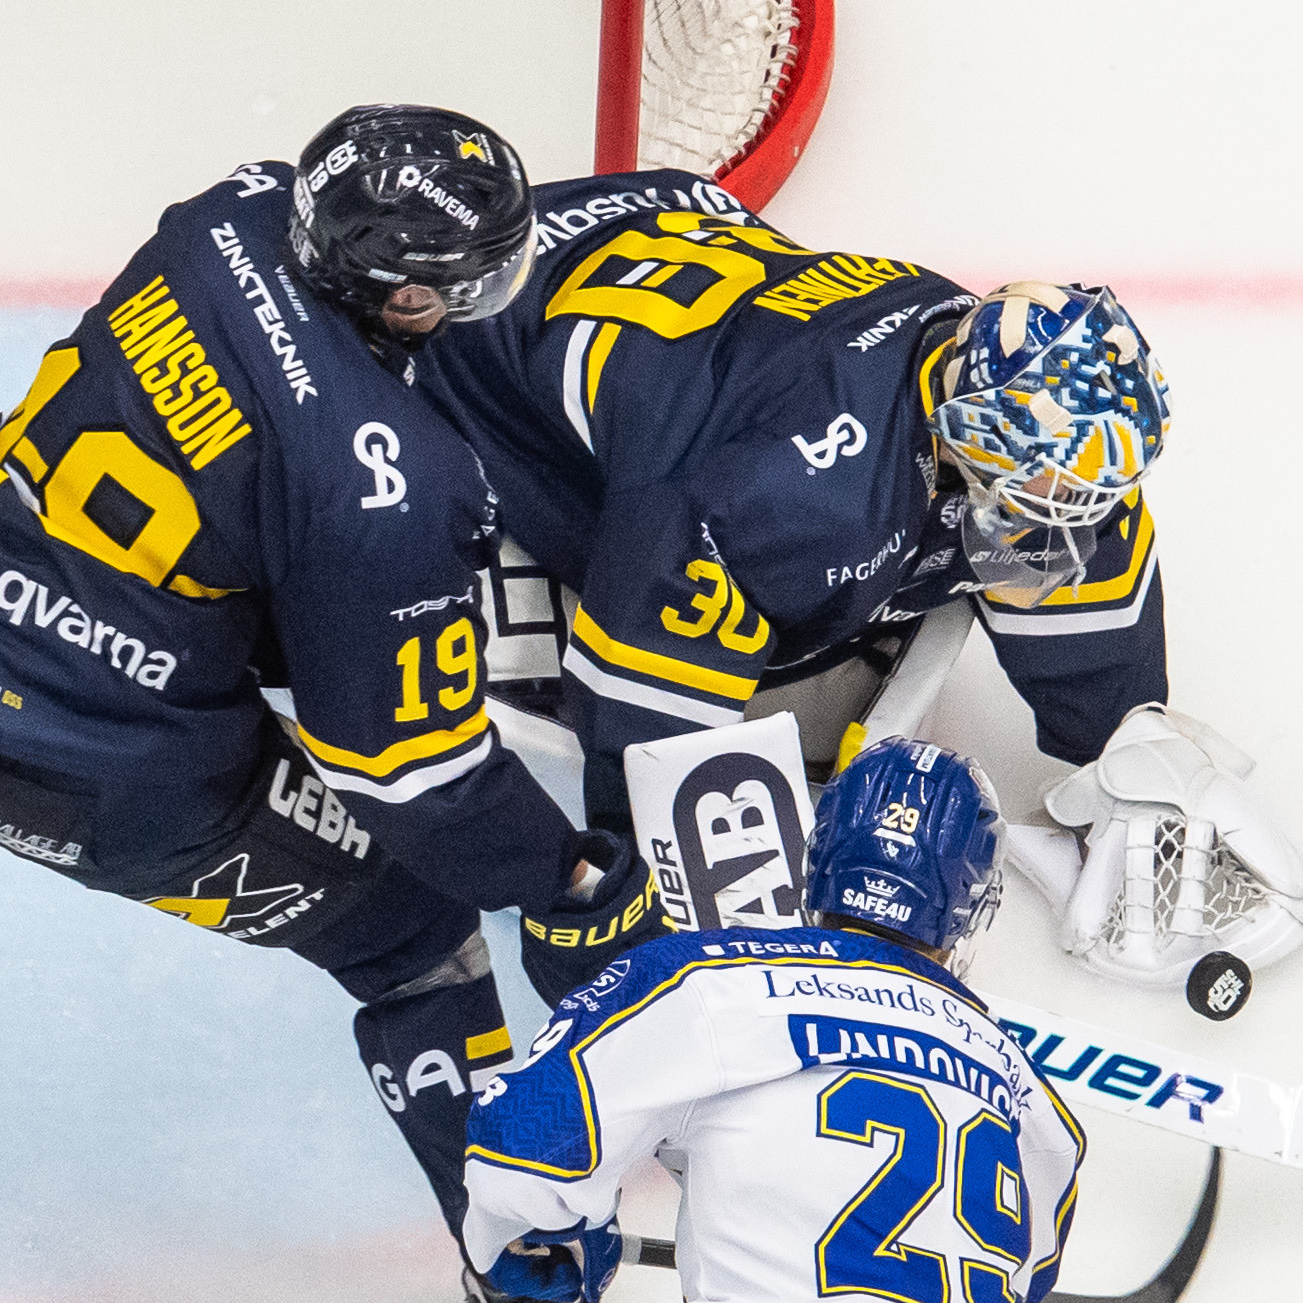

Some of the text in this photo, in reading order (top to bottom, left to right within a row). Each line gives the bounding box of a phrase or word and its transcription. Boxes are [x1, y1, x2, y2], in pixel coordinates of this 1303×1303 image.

[418, 180, 480, 231] RAVEMA
[210, 222, 319, 406] ZINKTEKNIK
[108, 274, 253, 471] HANSSON
[660, 558, 772, 655] 30
[394, 616, 479, 722] 19
[887, 802, 920, 834] 29
[841, 887, 911, 924] SAFE4U
[728, 940, 838, 959] TEGERA
[761, 969, 936, 1018] Leksands
